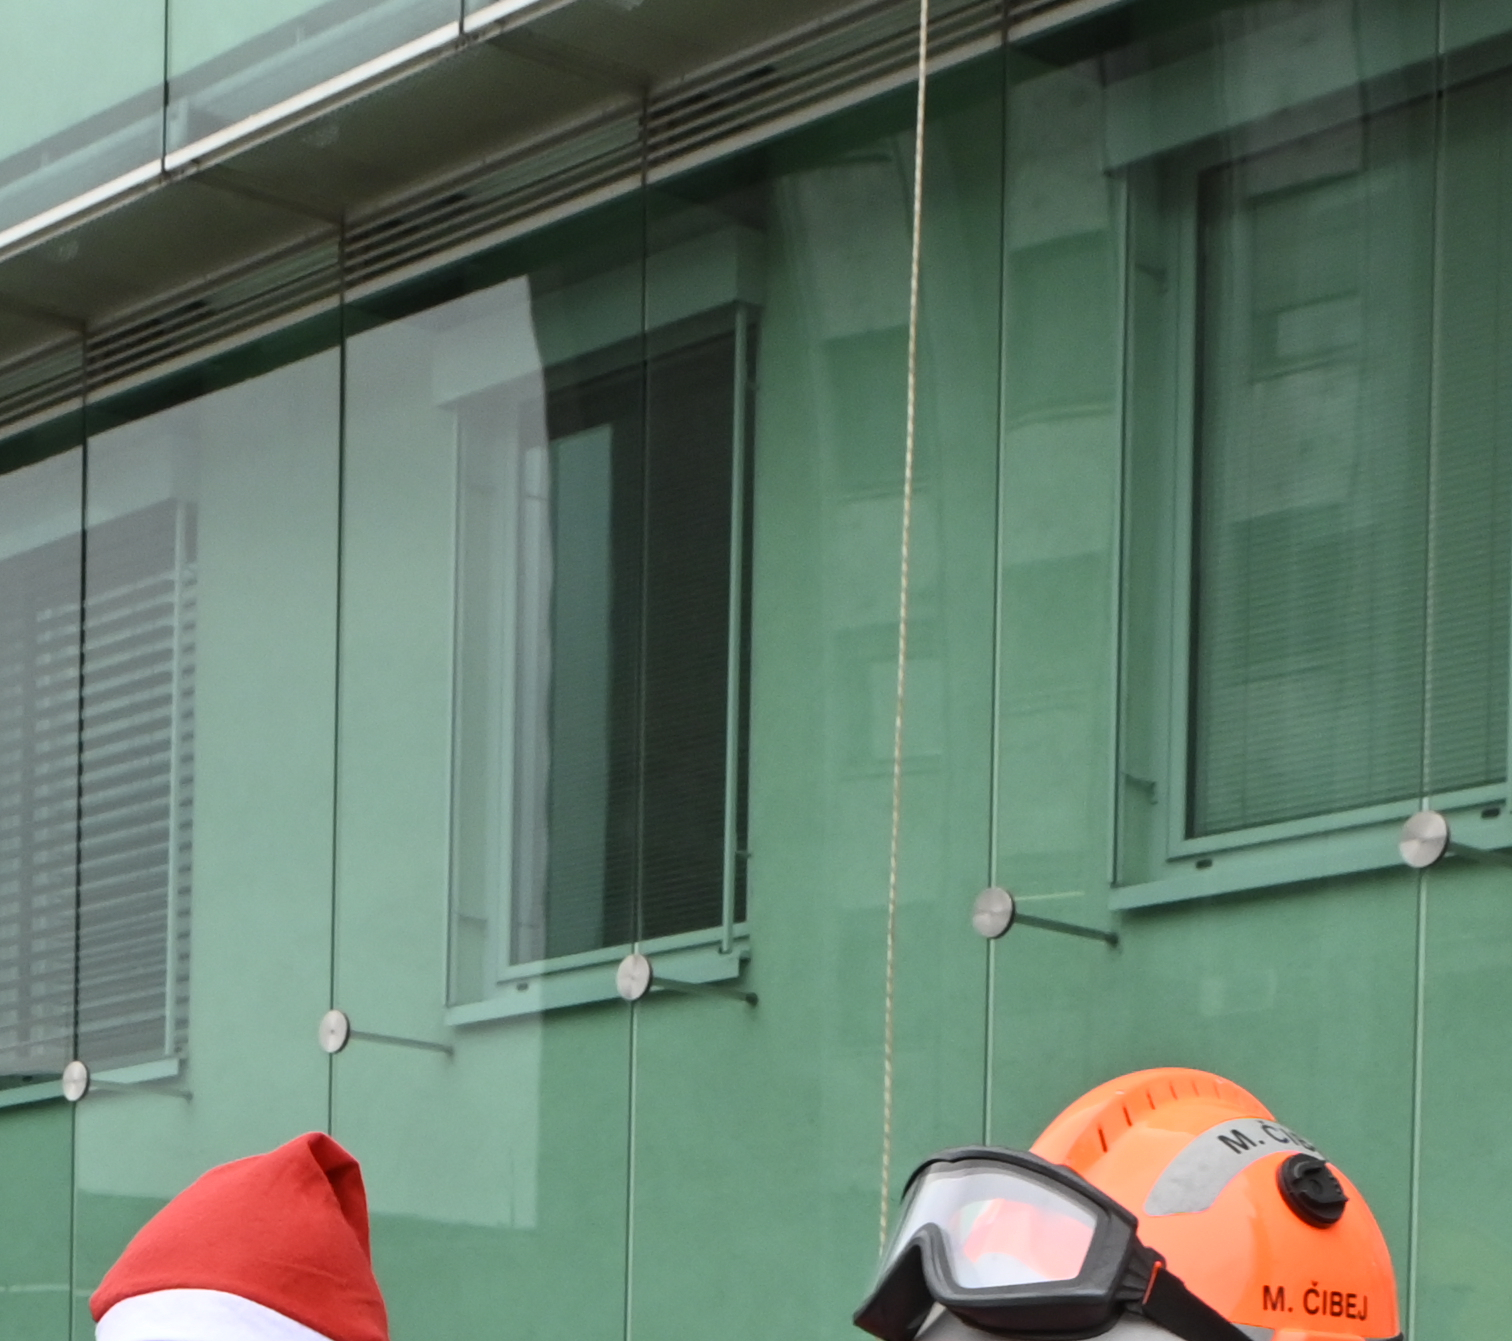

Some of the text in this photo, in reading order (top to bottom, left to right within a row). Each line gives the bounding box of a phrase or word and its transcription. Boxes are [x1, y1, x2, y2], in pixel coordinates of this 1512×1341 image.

[1217, 1129, 1266, 1155] M.
[1262, 1280, 1368, 1321] M. ČIBEJ
